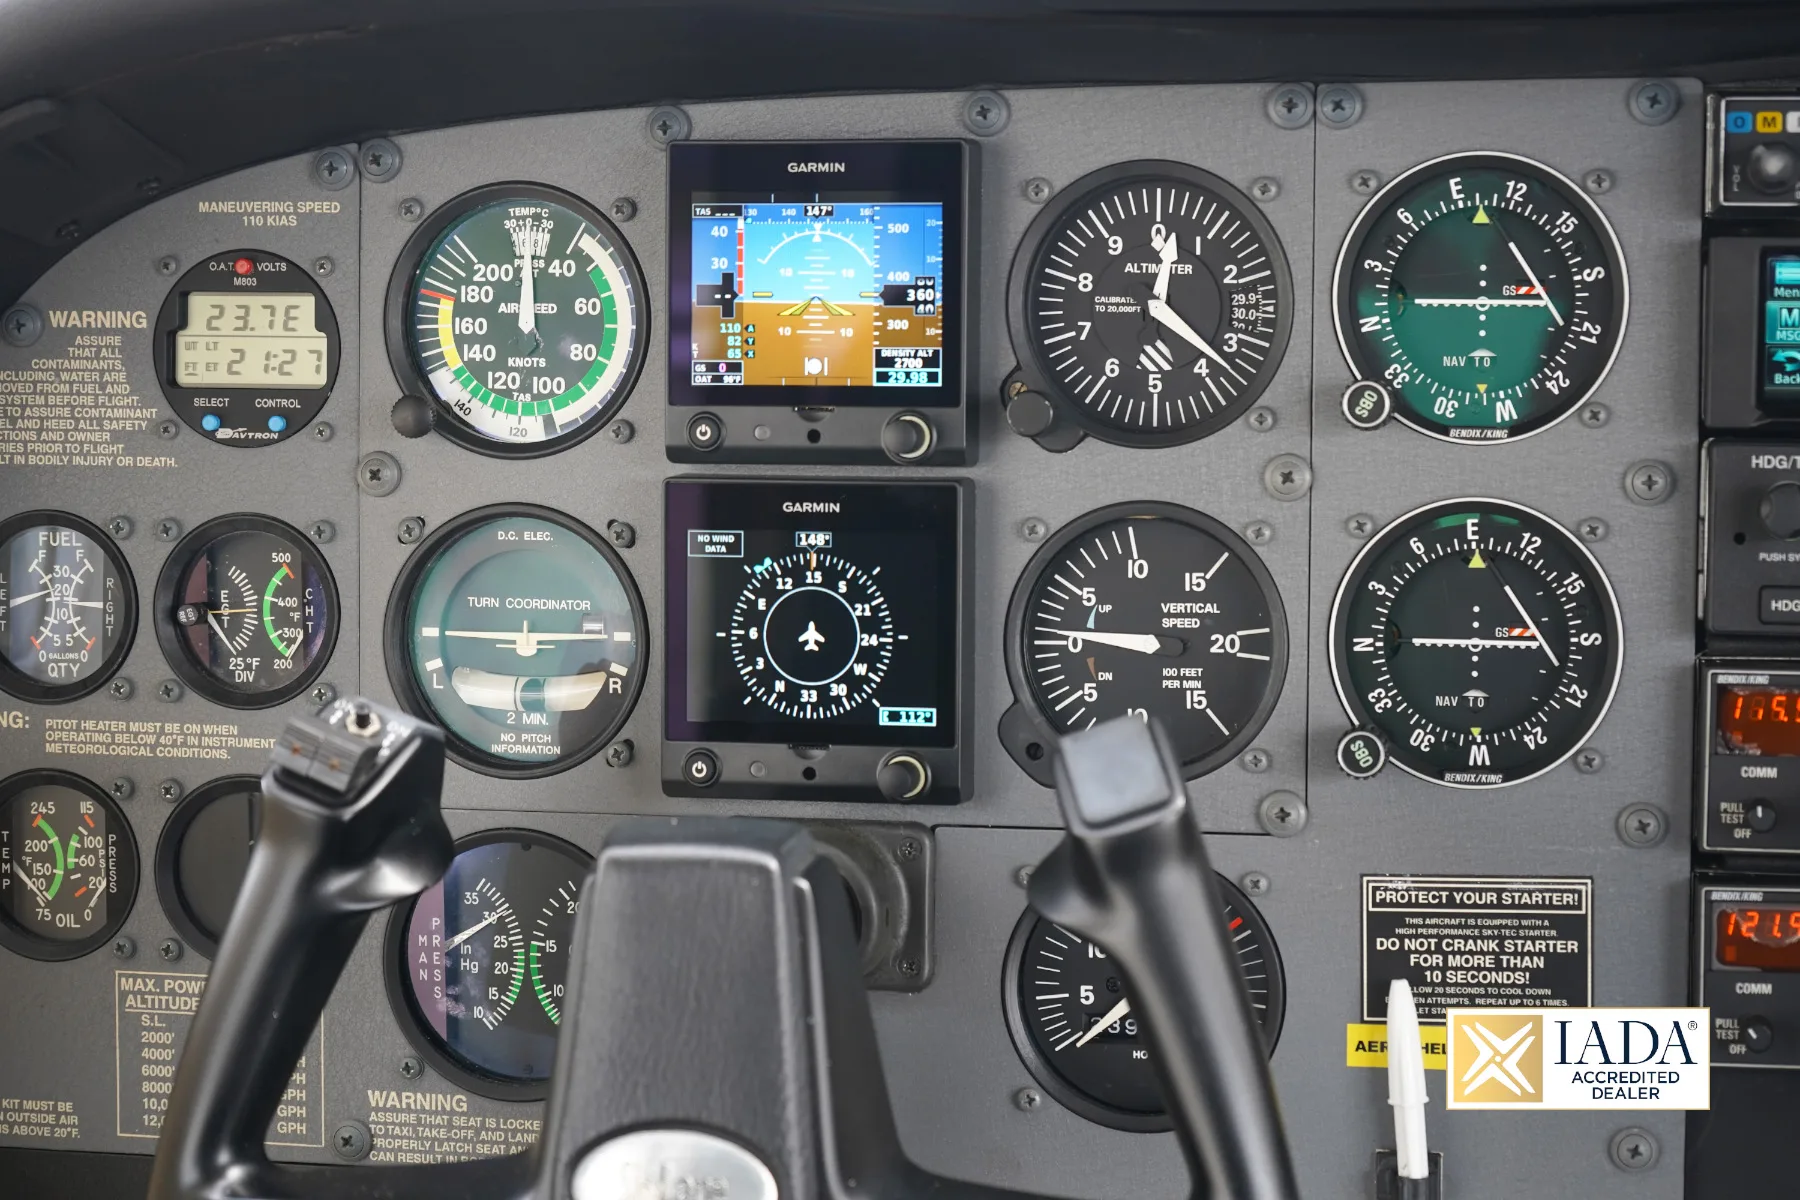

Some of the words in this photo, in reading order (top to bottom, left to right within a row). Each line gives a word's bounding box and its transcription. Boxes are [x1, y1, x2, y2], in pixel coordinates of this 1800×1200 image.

[788, 162, 845, 172] GARMIN
[1505, 181, 1527, 201] 12
[199, 202, 294, 213] MANEUVERING
[297, 202, 341, 213] SPEED
[242, 217, 264, 226] 110
[267, 217, 297, 226] KIAS
[888, 223, 909, 234] 500
[209, 262, 235, 271] O.A.T.
[256, 263, 286, 272] VOLTS
[473, 264, 513, 281] 200
[548, 260, 576, 277] 40
[1125, 263, 1192, 274] ALTIMTER
[233, 277, 257, 286] M803
[887, 272, 910, 282] 400
[461, 286, 493, 303] 180
[575, 298, 600, 315] 60
[49, 310, 147, 328] WARNING
[455, 318, 487, 334] 160
[887, 320, 908, 330] 300
[75, 336, 121, 346] ASSURE
[68, 348, 97, 357] THAT
[100, 348, 122, 357] ALL
[570, 344, 596, 361] 80
[881, 349, 914, 358] DENSITY
[31, 359, 125, 371] CONTAMINANTS,
[508, 358, 546, 367] KNOTS
[894, 358, 922, 368] 2700
[1443, 357, 1465, 367] NAV
[60, 372, 100, 381] WATER
[102, 372, 126, 382] ARE
[488, 372, 520, 389] 120
[888, 372, 928, 384] 29.98
[37, 384, 70, 394] FROM
[73, 384, 101, 394] FUEL
[105, 384, 129, 394] AND
[533, 377, 565, 394] 100
[53, 396, 95, 406] BEFORE
[98, 396, 141, 406] FLIGHT.
[193, 398, 229, 407] SELECT
[255, 399, 301, 408] CONTROL
[75, 408, 157, 418] CONTAMINANT
[103, 420, 147, 430] SAFETY
[1450, 428, 1508, 438] BENDIX/KING
[29, 455, 69, 465] BODILY
[73, 456, 113, 466] INJURY
[116, 457, 133, 466] OR
[137, 457, 178, 467] DEATH.
[782, 502, 840, 512] GARMIN
[39, 532, 82, 546] FUEL
[498, 531, 518, 540] D.C.
[524, 532, 553, 541] ELEC.
[712, 535, 734, 543] WIND
[272, 553, 291, 562] 500
[1759, 553, 1785, 561] PUSH
[53, 565, 70, 578] 30
[1127, 559, 1148, 579] 10
[1185, 572, 1206, 591] 15
[278, 597, 297, 607] 400
[468, 597, 499, 608] TURN
[506, 599, 590, 610] COORDINATOR
[1161, 603, 1220, 614] VERTICAL
[1162, 618, 1200, 628] SPEED
[1210, 634, 1240, 653] 20
[273, 659, 292, 669] 200
[48, 663, 80, 678] QTY
[1180, 669, 1203, 677] FEET
[235, 671, 255, 682] DIV
[1717, 675, 1769, 684] BENDIX/KING
[1163, 680, 1180, 688] PER
[1183, 680, 1201, 688] MIN
[523, 714, 549, 725] MIN.
[46, 719, 77, 729] PITOT
[81, 720, 126, 731] HEATER
[129, 722, 162, 733] MUST
[165, 723, 180, 733] BE
[184, 724, 200, 734] ON
[203, 724, 237, 735] WHEN
[46, 731, 111, 743] OPERATING
[115, 734, 156, 745] BELOW
[202, 737, 276, 749] INSTRUMENT
[501, 734, 515, 742] NO
[522, 734, 551, 743] PITCH
[46, 743, 153, 757] METEOROLOGICAL
[157, 748, 231, 759] CONDITIONS.
[492, 745, 560, 754] INFORMATION
[1444, 773, 1502, 783] BENDIX/KING
[1741, 767, 1777, 778] COMM
[30, 802, 55, 814] 245
[1721, 803, 1744, 812] PULL
[1721, 814, 1744, 823] TEST
[1734, 829, 1751, 838] OFF
[464, 892, 479, 904] 35
[1376, 891, 1449, 905] PROTECT
[1453, 892, 1497, 905] YOUR
[1502, 892, 1578, 906] STARTER!
[56, 914, 80, 927] OIL
[1425, 918, 1465, 926] AIRCRAFT
[1418, 928, 1480, 936] PERFORMANCE
[1376, 938, 1400, 951] DO
[1404, 939, 1438, 952] NOT
[1442, 939, 1500, 952] CRANK
[1504, 940, 1578, 953] STARTER
[1410, 955, 1444, 967] FOR
[1448, 955, 1495, 967] MORE
[1500, 956, 1544, 968] THAN
[1424, 971, 1442, 983] 10
[1446, 971, 1529, 984] SECONDS!
[121, 978, 159, 992] MAX.
[1736, 983, 1772, 994] COMM
[125, 995, 199, 1010] ALTITUDE
[1427, 997, 1471, 1005] ATTEMPTS.
[141, 1015, 165, 1026] S.L.
[1715, 1018, 1740, 1028] PULL
[141, 1032, 175, 1043] 2000'
[1716, 1029, 1740, 1039] TEST
[368, 1090, 467, 1111] WARNING
[277, 1106, 305, 1117] GPH
[7, 1113, 56, 1123] OUTSIDE
[59, 1115, 78, 1124] AIR
[369, 1112, 418, 1124] ASSURE
[419, 1114, 450, 1125] THAT
[452, 1116, 483, 1127] SEAT
[13, 1126, 50, 1136] ABOVE
[387, 1125, 415, 1137] TAXI,
[417, 1127, 477, 1141] TAKE-OFF,
[434, 1141, 473, 1153] LATCH
[398, 1152, 443, 1164] RESULT
